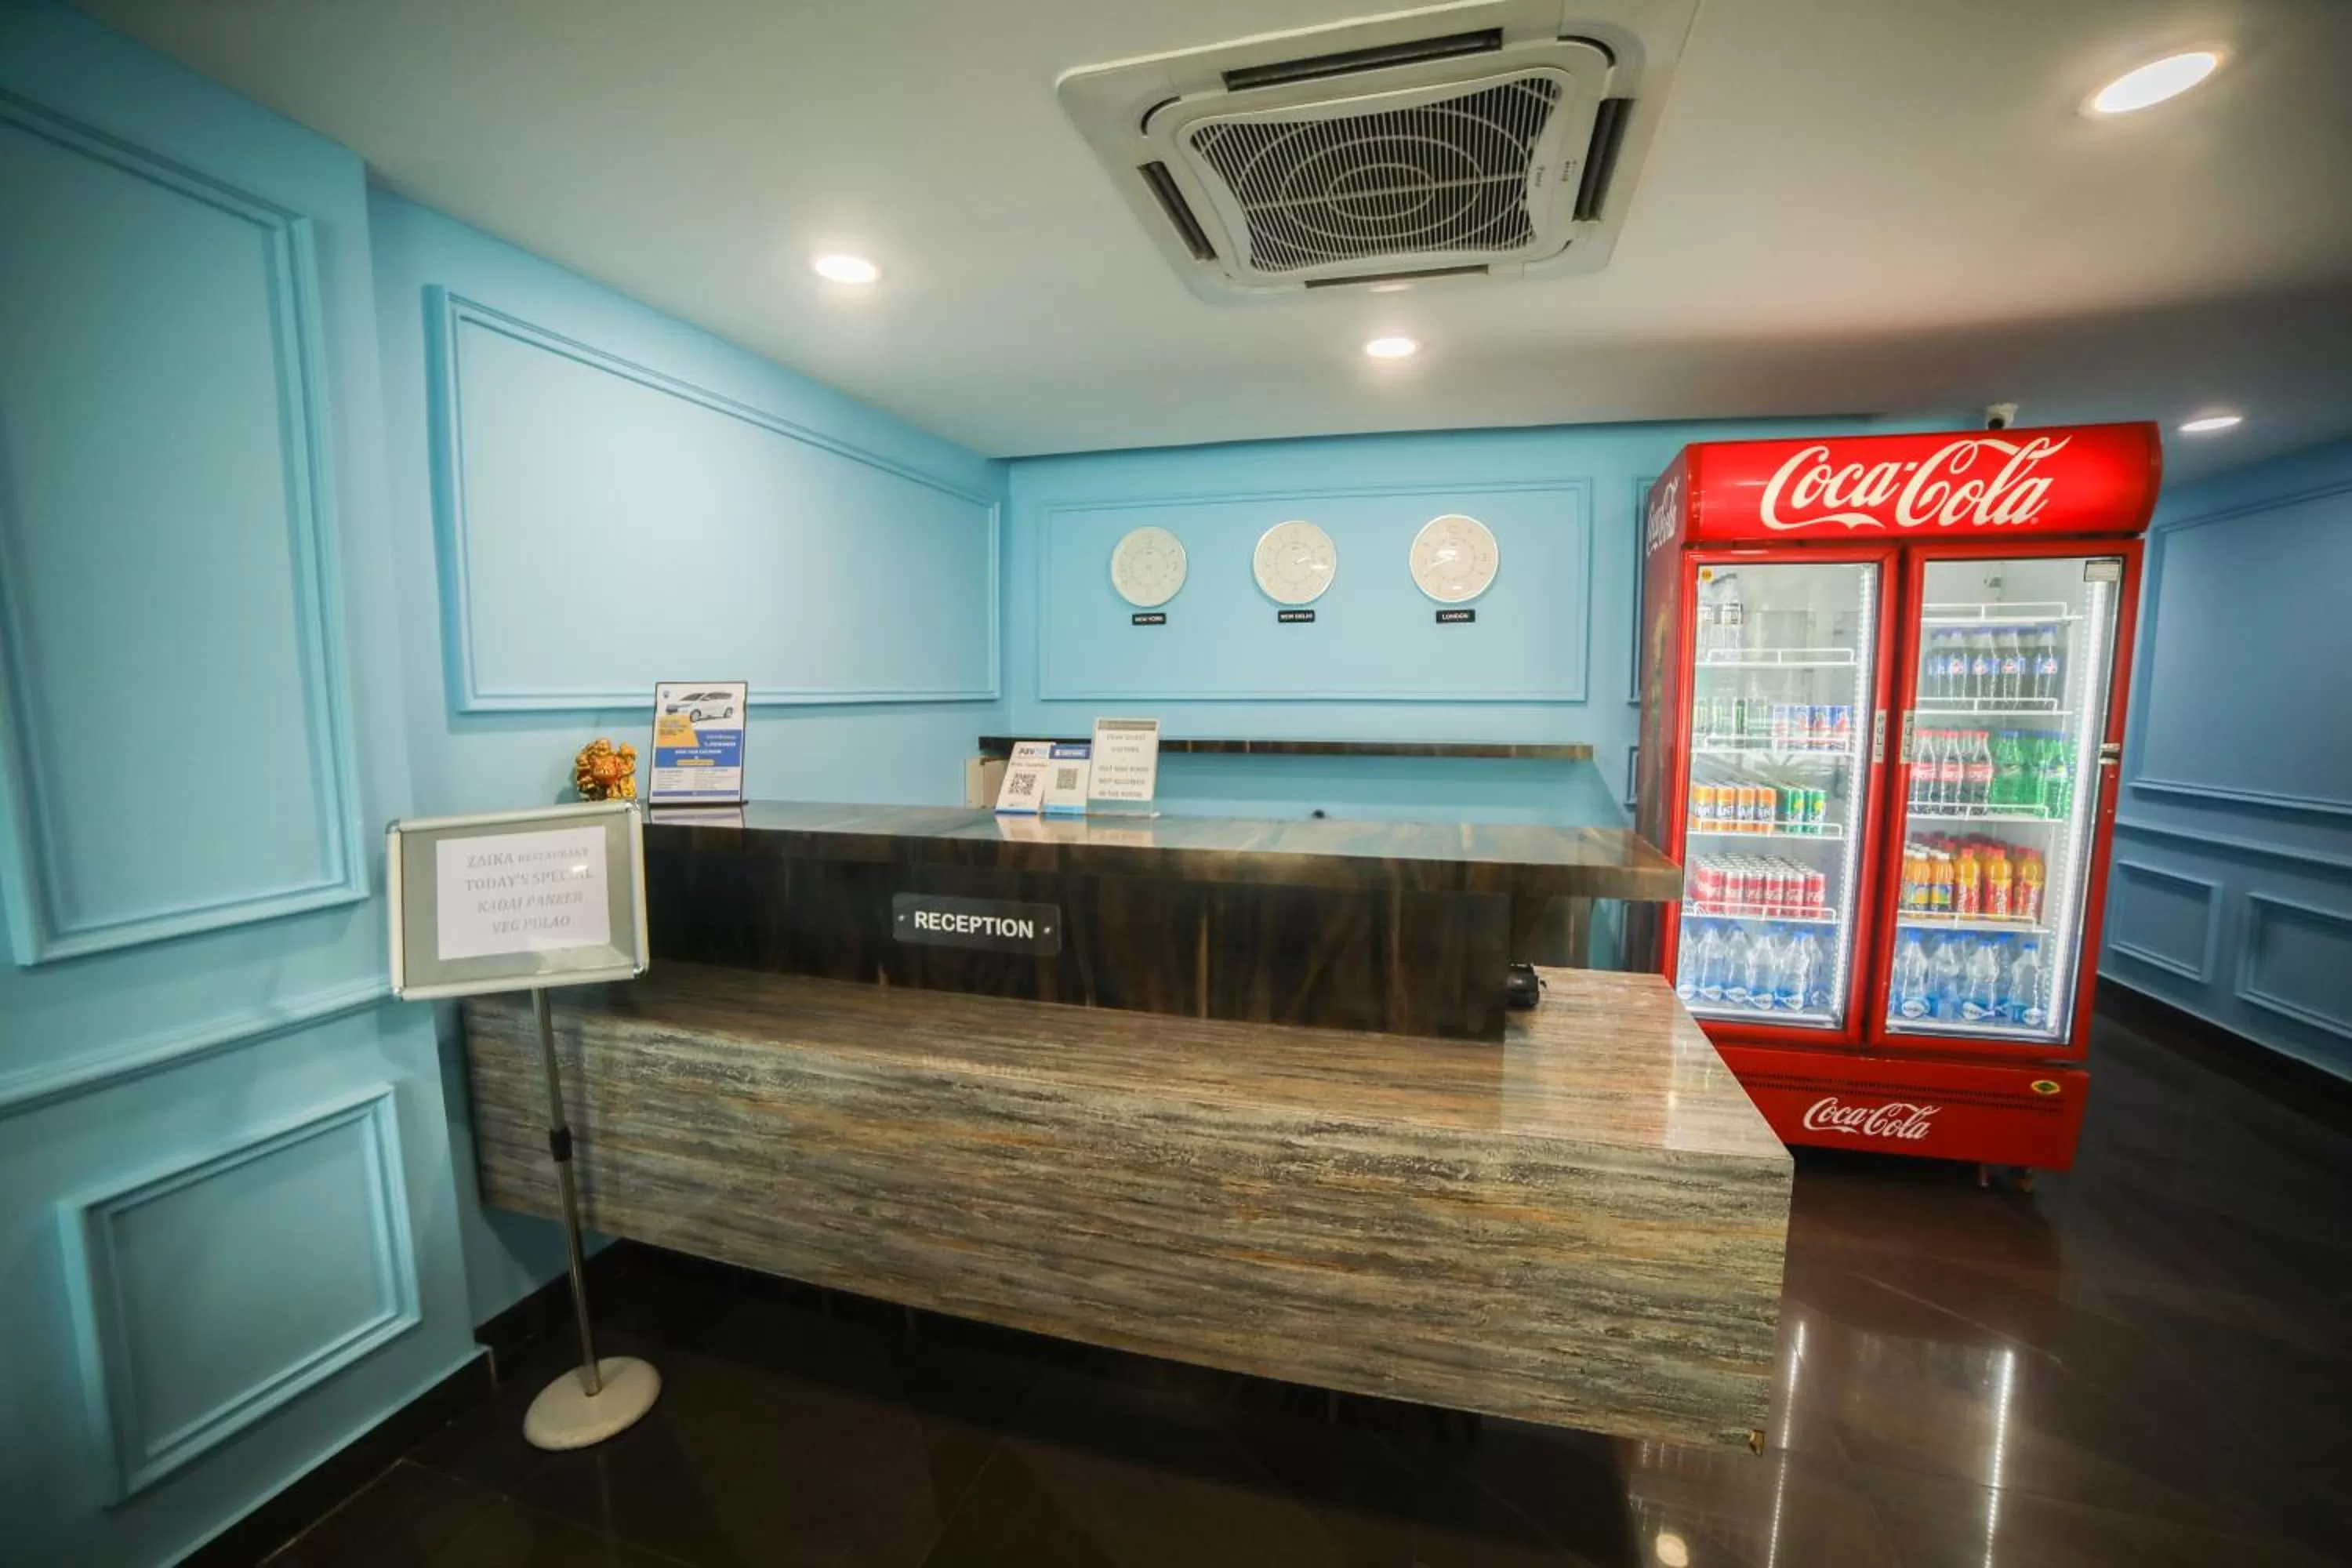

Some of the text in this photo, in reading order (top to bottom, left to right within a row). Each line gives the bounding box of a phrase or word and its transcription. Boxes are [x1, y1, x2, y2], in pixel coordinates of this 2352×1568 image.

[1760, 435, 2072, 530] Coca-Cola
[466, 852, 514, 868] ZAIKA
[464, 872, 529, 891] TODAY'S
[492, 915, 572, 935] VEG PULAO
[914, 910, 1034, 938] RECEPTION
[1803, 1097, 1943, 1140] Coca-Cola
